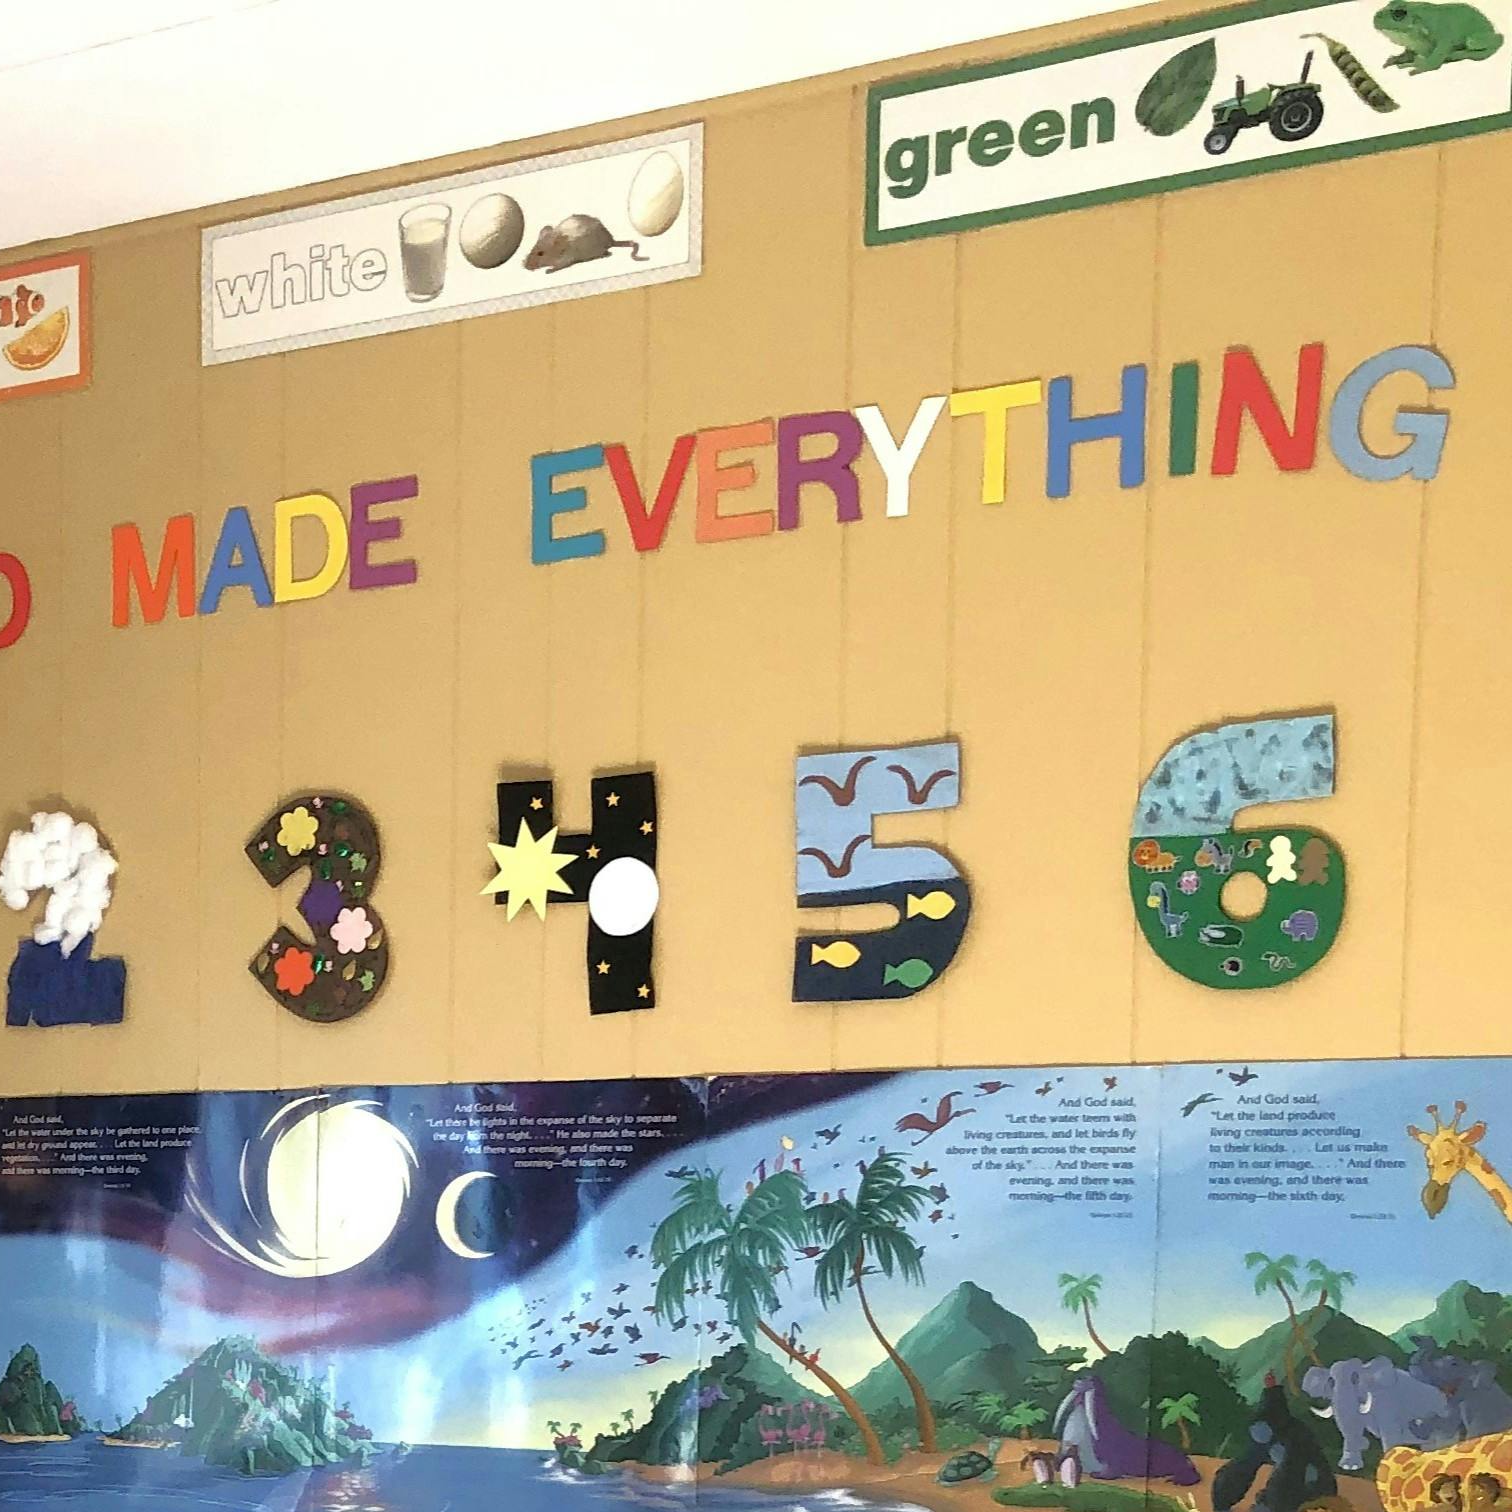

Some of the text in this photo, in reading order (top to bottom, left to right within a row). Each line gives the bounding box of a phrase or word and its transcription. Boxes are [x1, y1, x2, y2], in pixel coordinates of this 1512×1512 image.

[885, 95, 1116, 198] green
[215, 243, 388, 318] white
[111, 474, 419, 628] MADE
[530, 342, 1457, 565] EVERYTHING
[246, 796, 386, 1022] 3
[492, 772, 659, 1015] 4
[793, 743, 971, 1002] 5
[1128, 714, 1345, 989] 6
